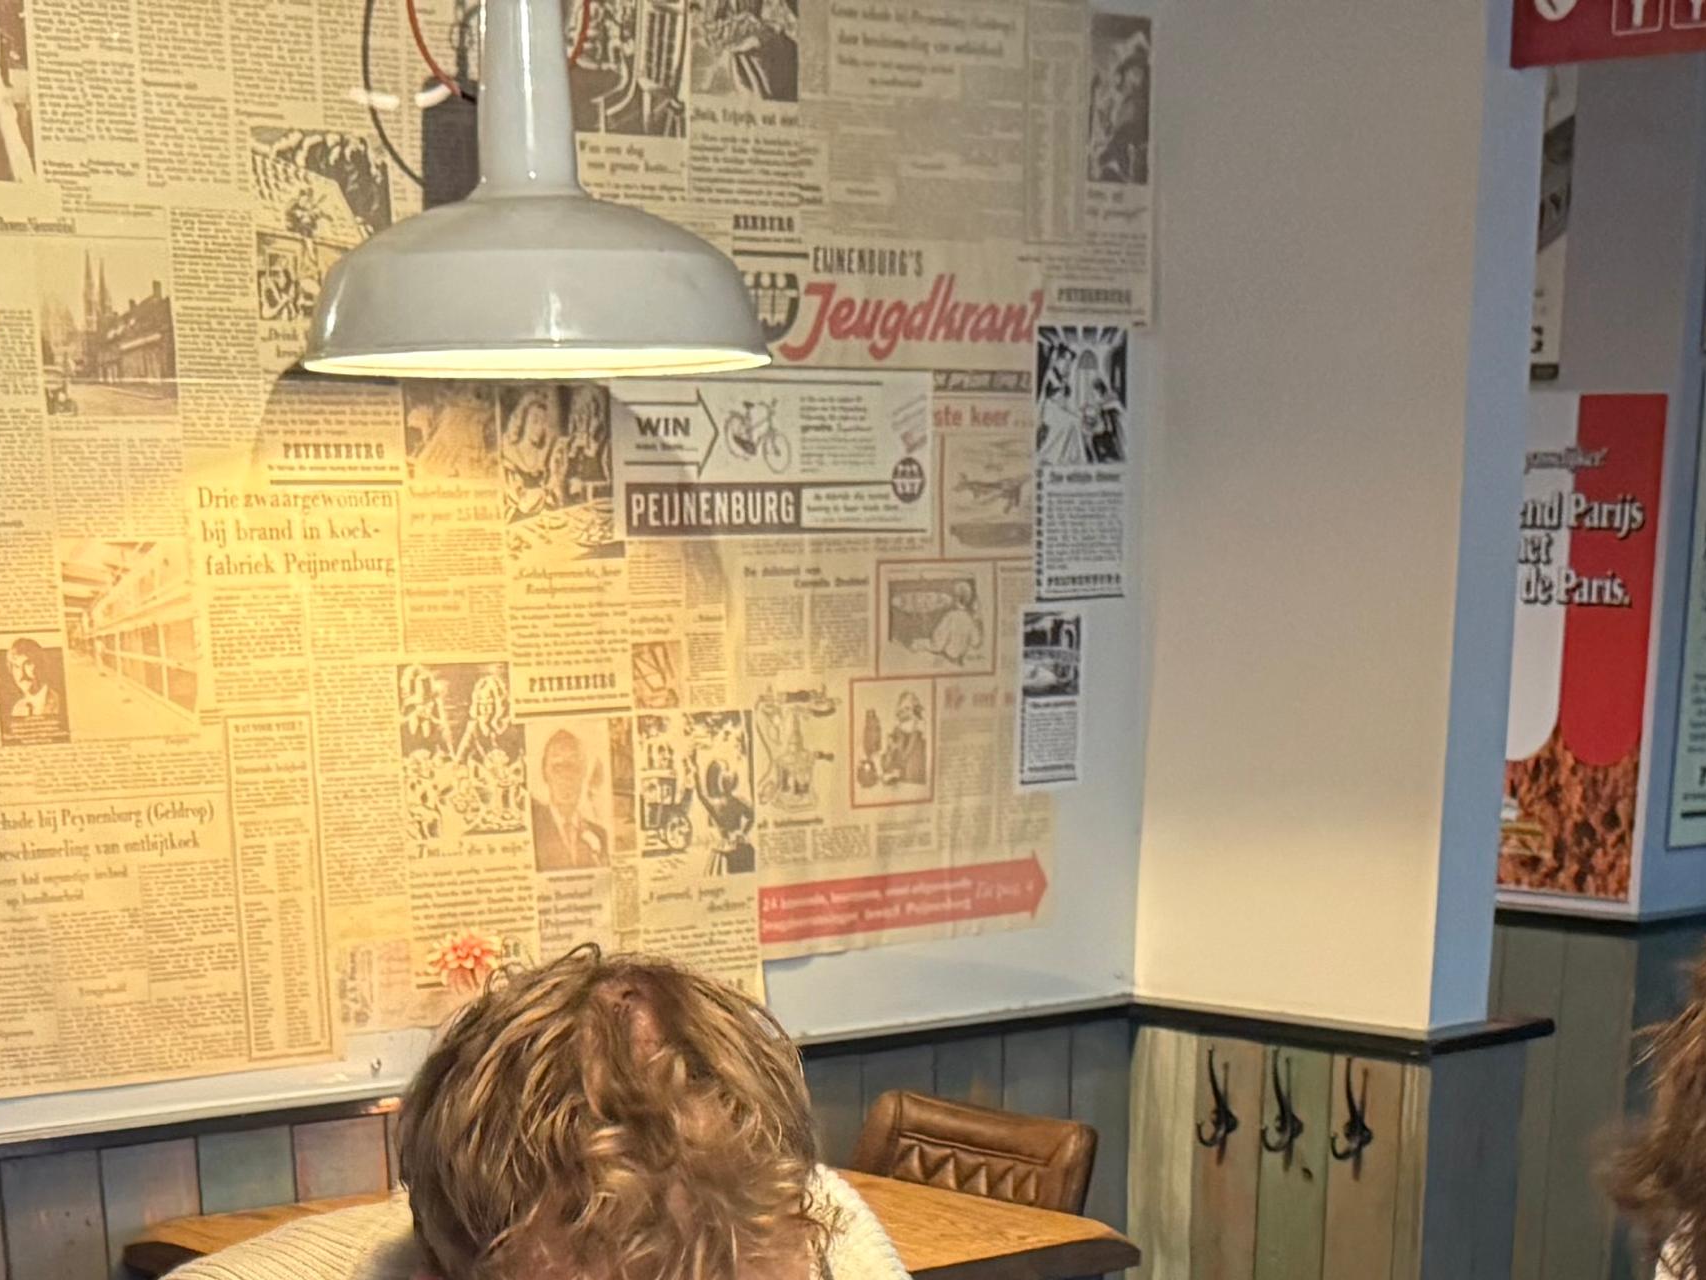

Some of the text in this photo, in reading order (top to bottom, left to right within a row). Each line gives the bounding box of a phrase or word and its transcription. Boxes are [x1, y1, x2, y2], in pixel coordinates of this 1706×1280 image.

[812, 246, 924, 278] EIJNENBURG'S
[635, 416, 691, 438] WIN
[198, 487, 393, 513] Drie zwaargewonden
[631, 490, 795, 527] PEIJNENBURG
[1568, 492, 1646, 540] Parijs
[202, 518, 381, 547] bij brand in koek-
[205, 550, 397, 580] fabriek Peijnenburg
[1520, 565, 1633, 608] de Paris.
[146, 800, 215, 827] (Geldrop)
